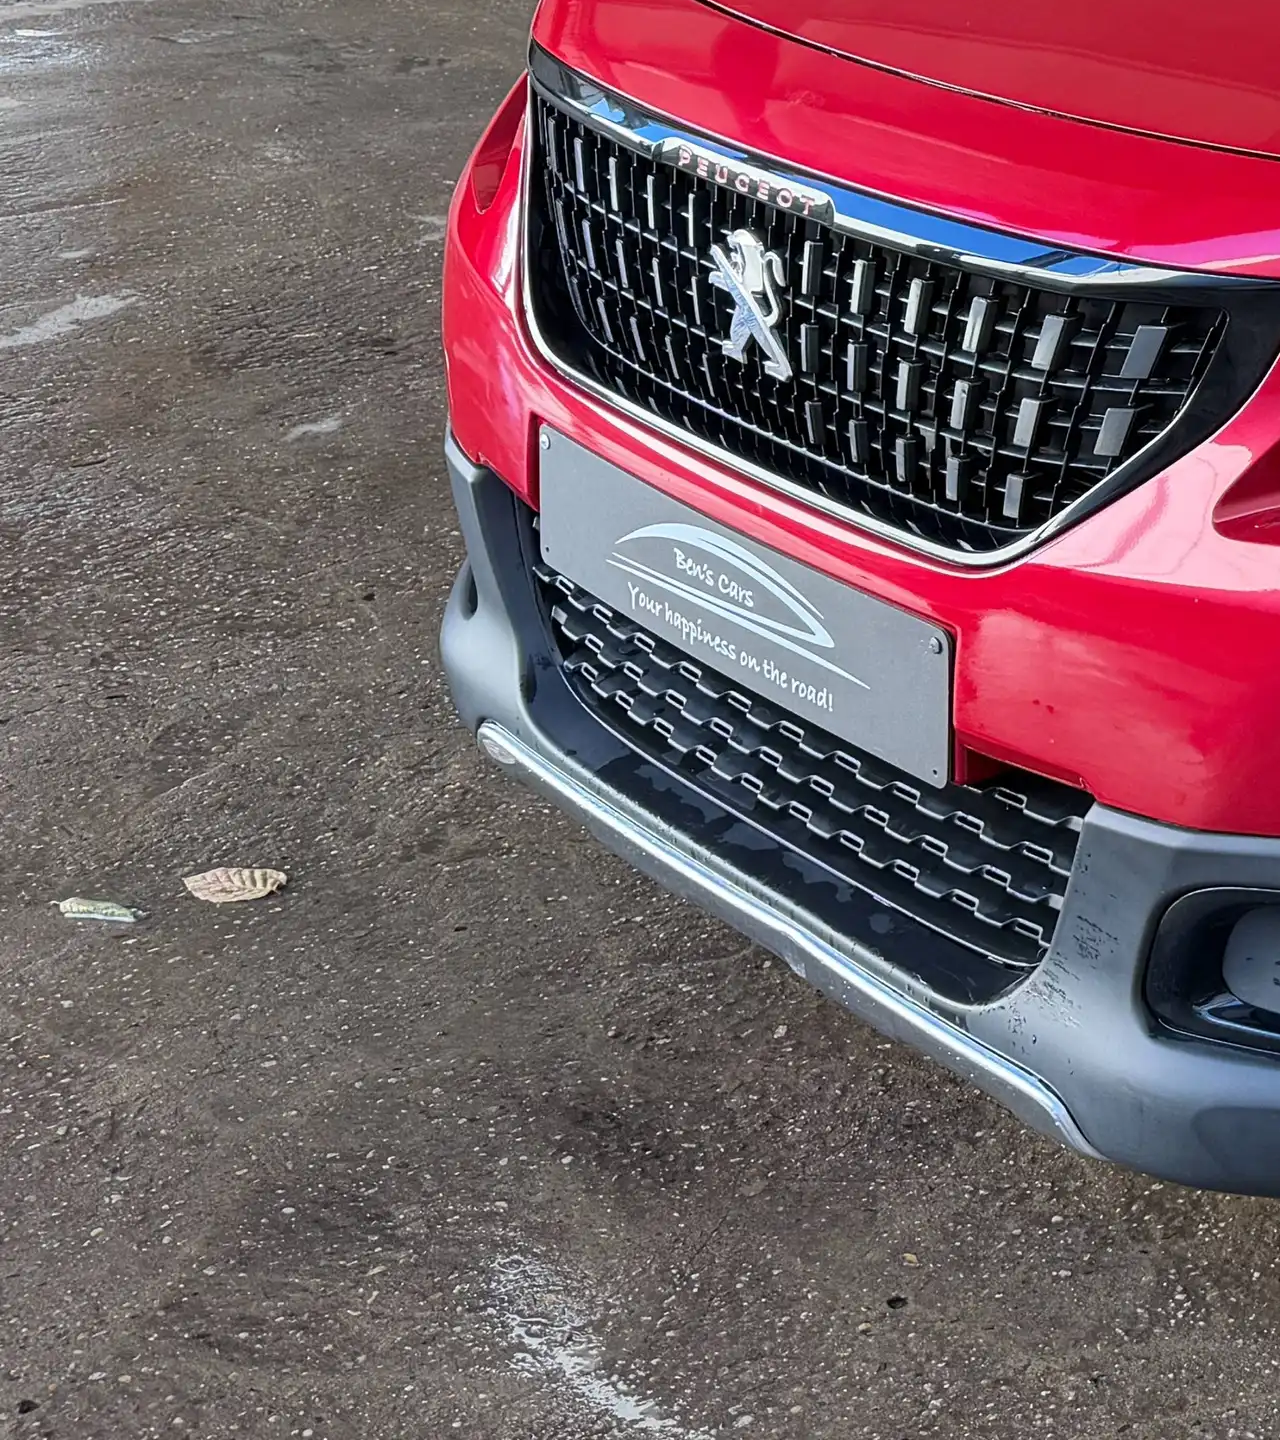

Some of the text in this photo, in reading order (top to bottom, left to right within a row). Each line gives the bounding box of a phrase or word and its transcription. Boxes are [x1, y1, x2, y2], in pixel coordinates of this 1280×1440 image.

[678, 145, 815, 215] PEUGEOT
[674, 547, 755, 607] Ben's Cars
[628, 582, 835, 712] Your happiness on the road!
